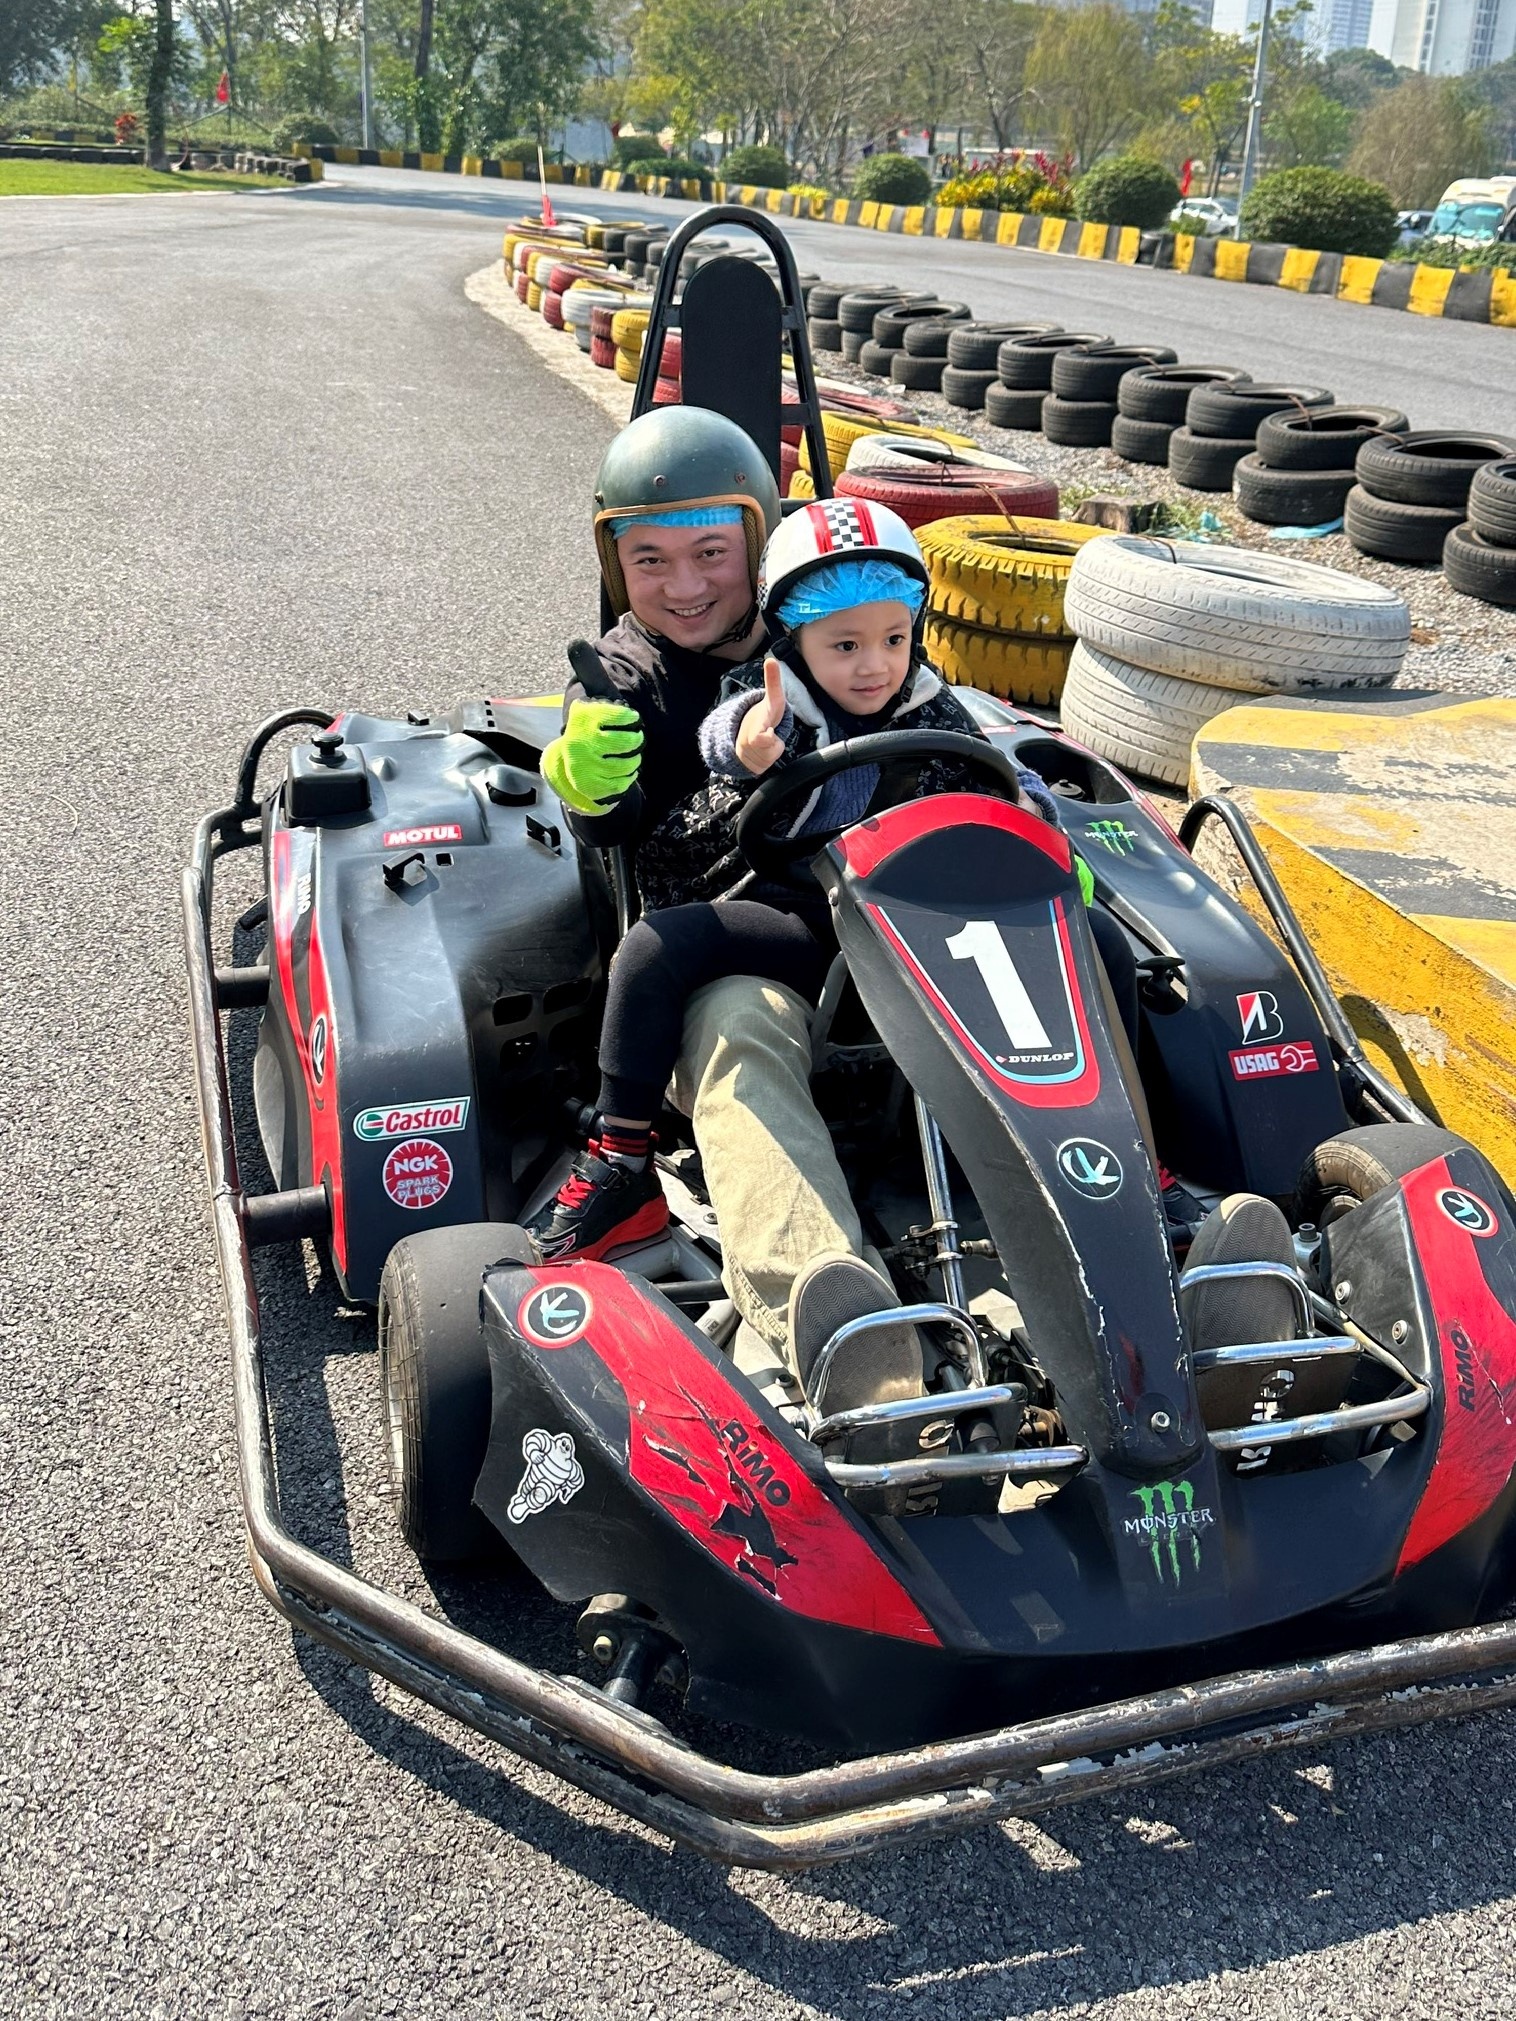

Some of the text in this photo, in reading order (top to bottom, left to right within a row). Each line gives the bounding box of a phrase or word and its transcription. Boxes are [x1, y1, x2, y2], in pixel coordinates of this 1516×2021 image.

[388, 826, 459, 846] MOTUL
[945, 920, 1053, 1050] 1
[1008, 1052, 1075, 1064] DUNLOP
[1234, 1052, 1281, 1075] USAG
[385, 1104, 461, 1133] Castrol
[393, 1153, 439, 1176] NGK
[396, 1174, 439, 1190] SPARK
[397, 1184, 440, 1200] PLUGS
[1124, 1507, 1215, 1535] MONSTER
